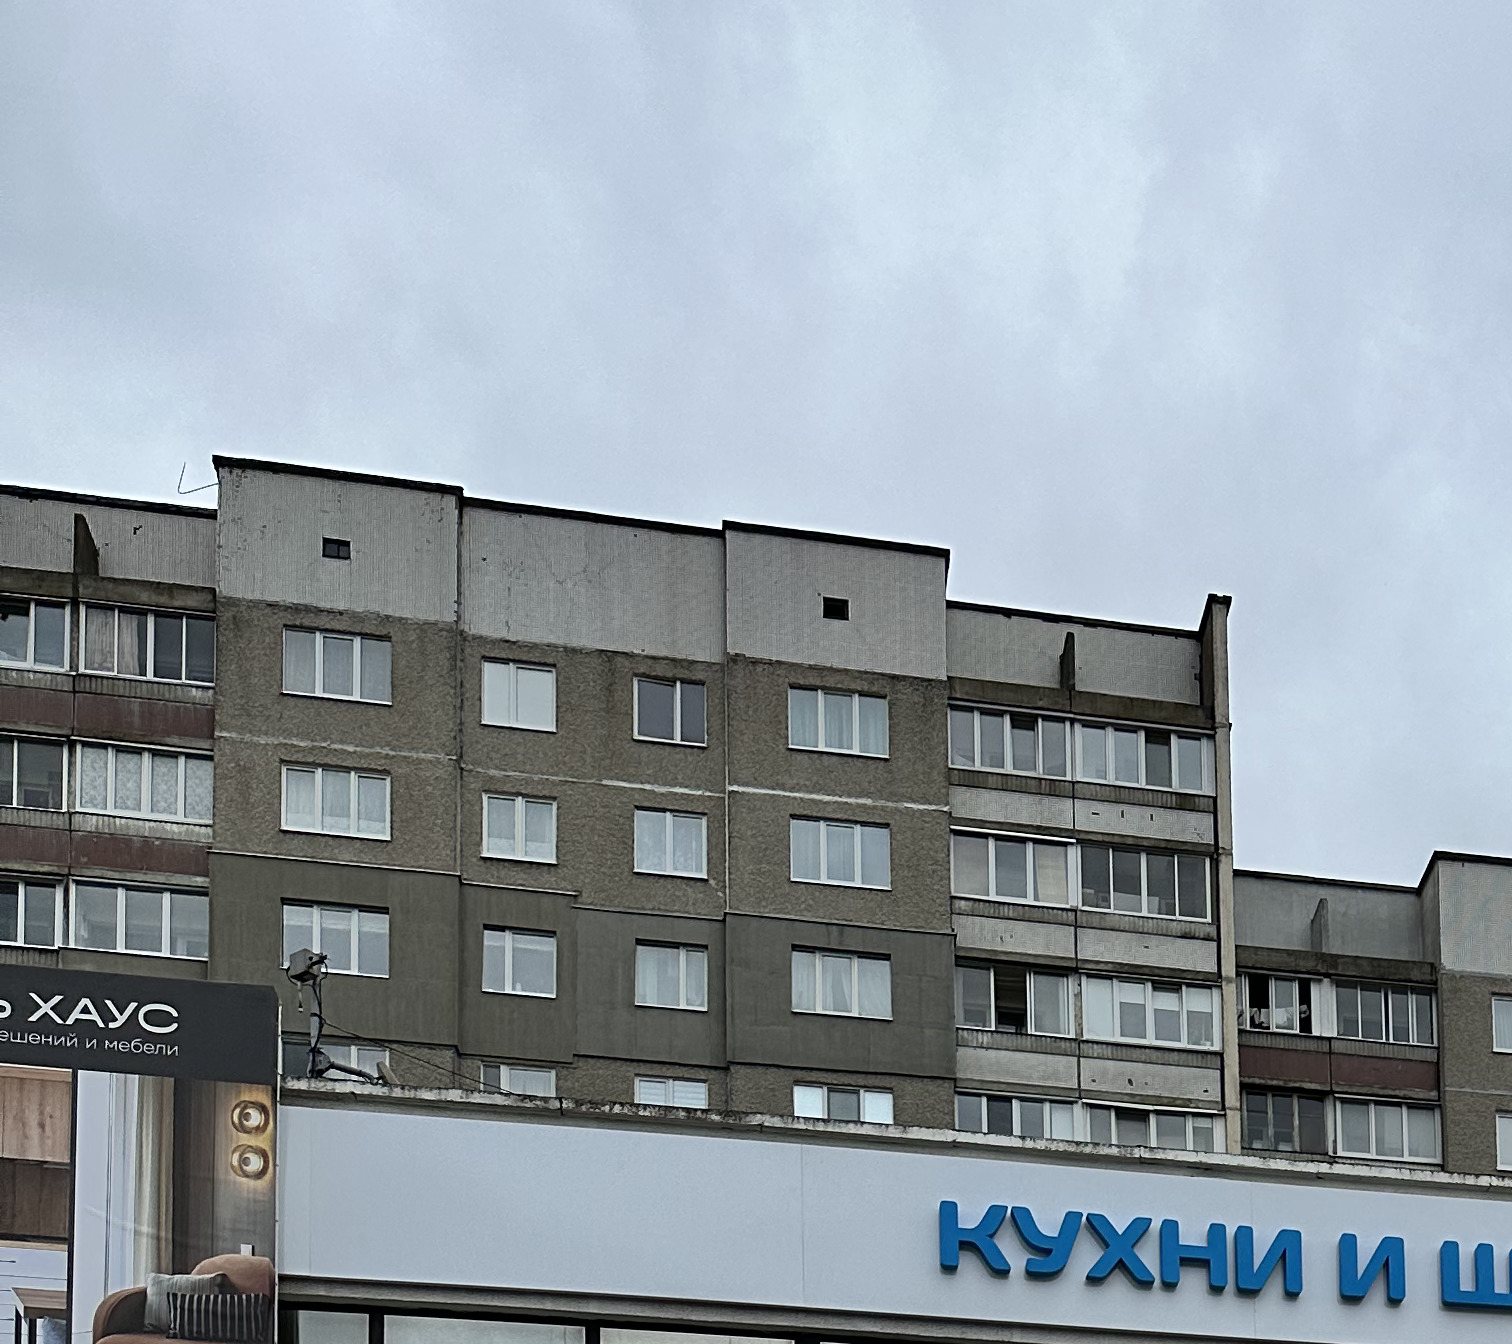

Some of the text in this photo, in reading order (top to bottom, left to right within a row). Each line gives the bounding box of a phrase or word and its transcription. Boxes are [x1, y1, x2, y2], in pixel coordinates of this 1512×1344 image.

[27, 992, 179, 1034] ХАУС
[86, 1037, 97, 1050] и
[105, 1038, 179, 1056] мебели
[939, 1200, 1302, 1297] КУХНИ
[1338, 1232, 1406, 1303] И
